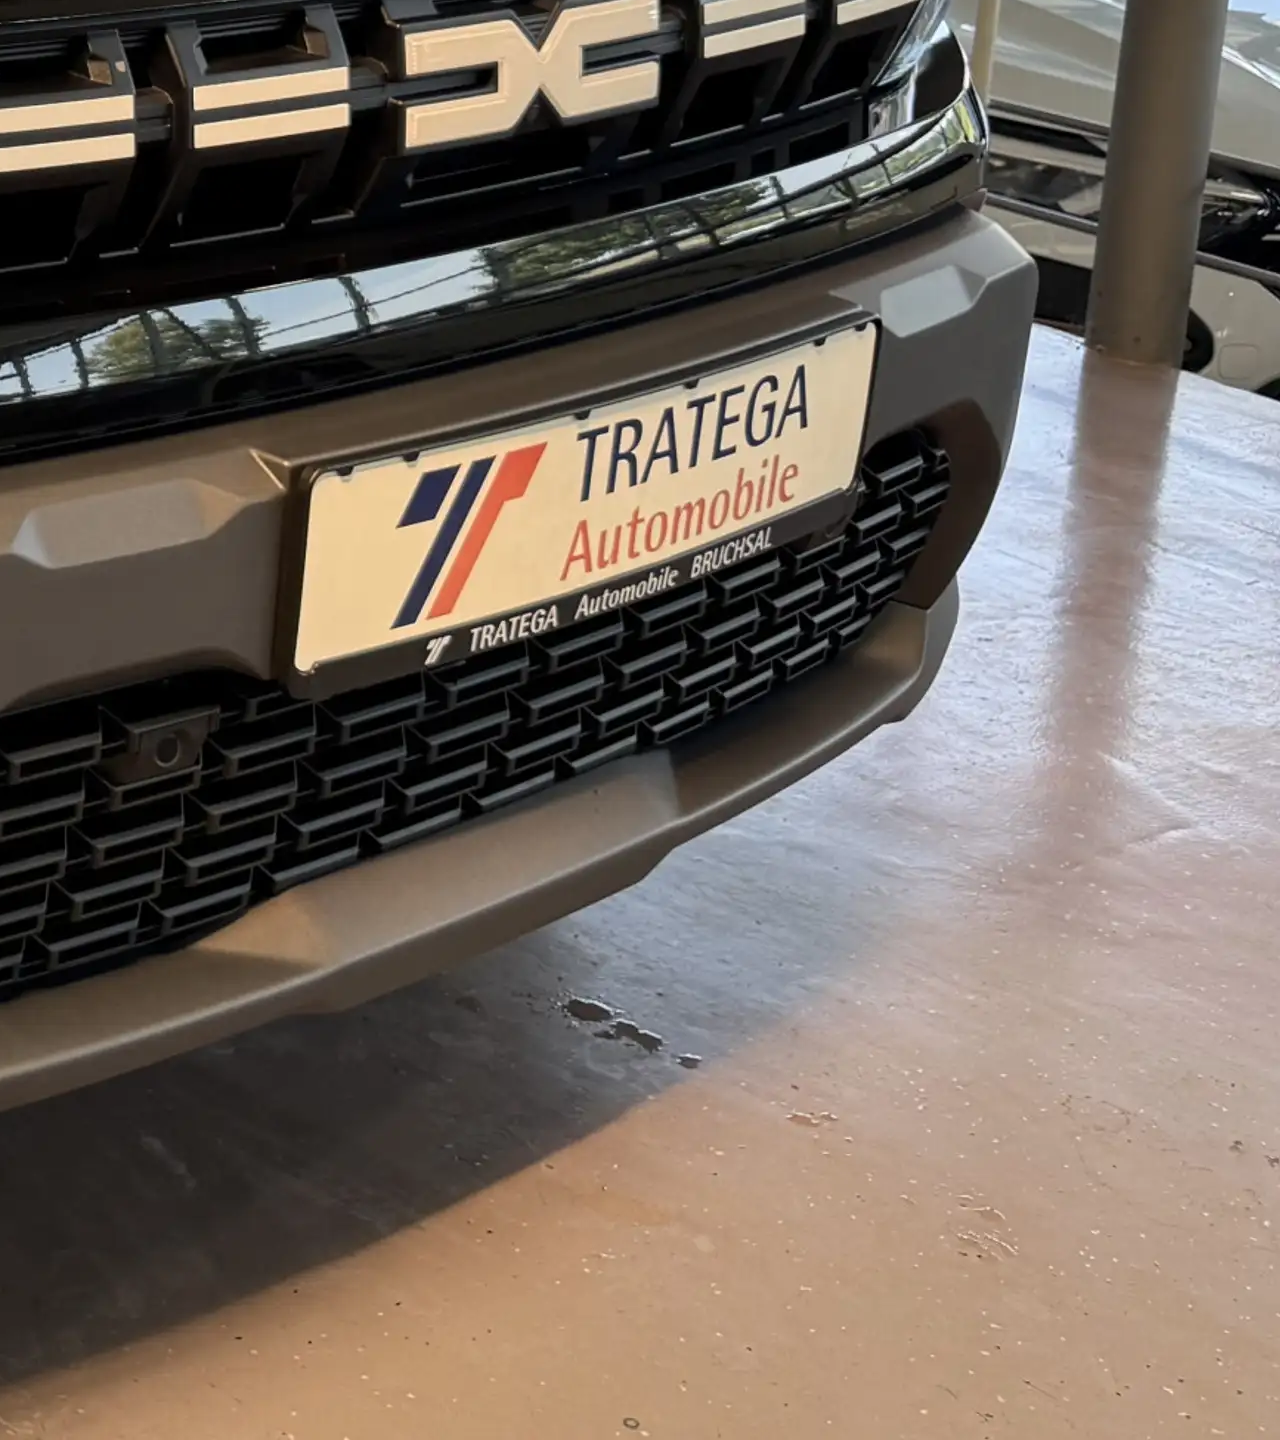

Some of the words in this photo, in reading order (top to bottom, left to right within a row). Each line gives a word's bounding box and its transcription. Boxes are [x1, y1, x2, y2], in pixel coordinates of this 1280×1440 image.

[576, 363, 809, 503] TRATEGA
[558, 453, 800, 582] Automobile
[469, 604, 559, 653] TRATEGA
[573, 565, 680, 621] Automobile
[689, 525, 774, 579] BRUCHSAL
